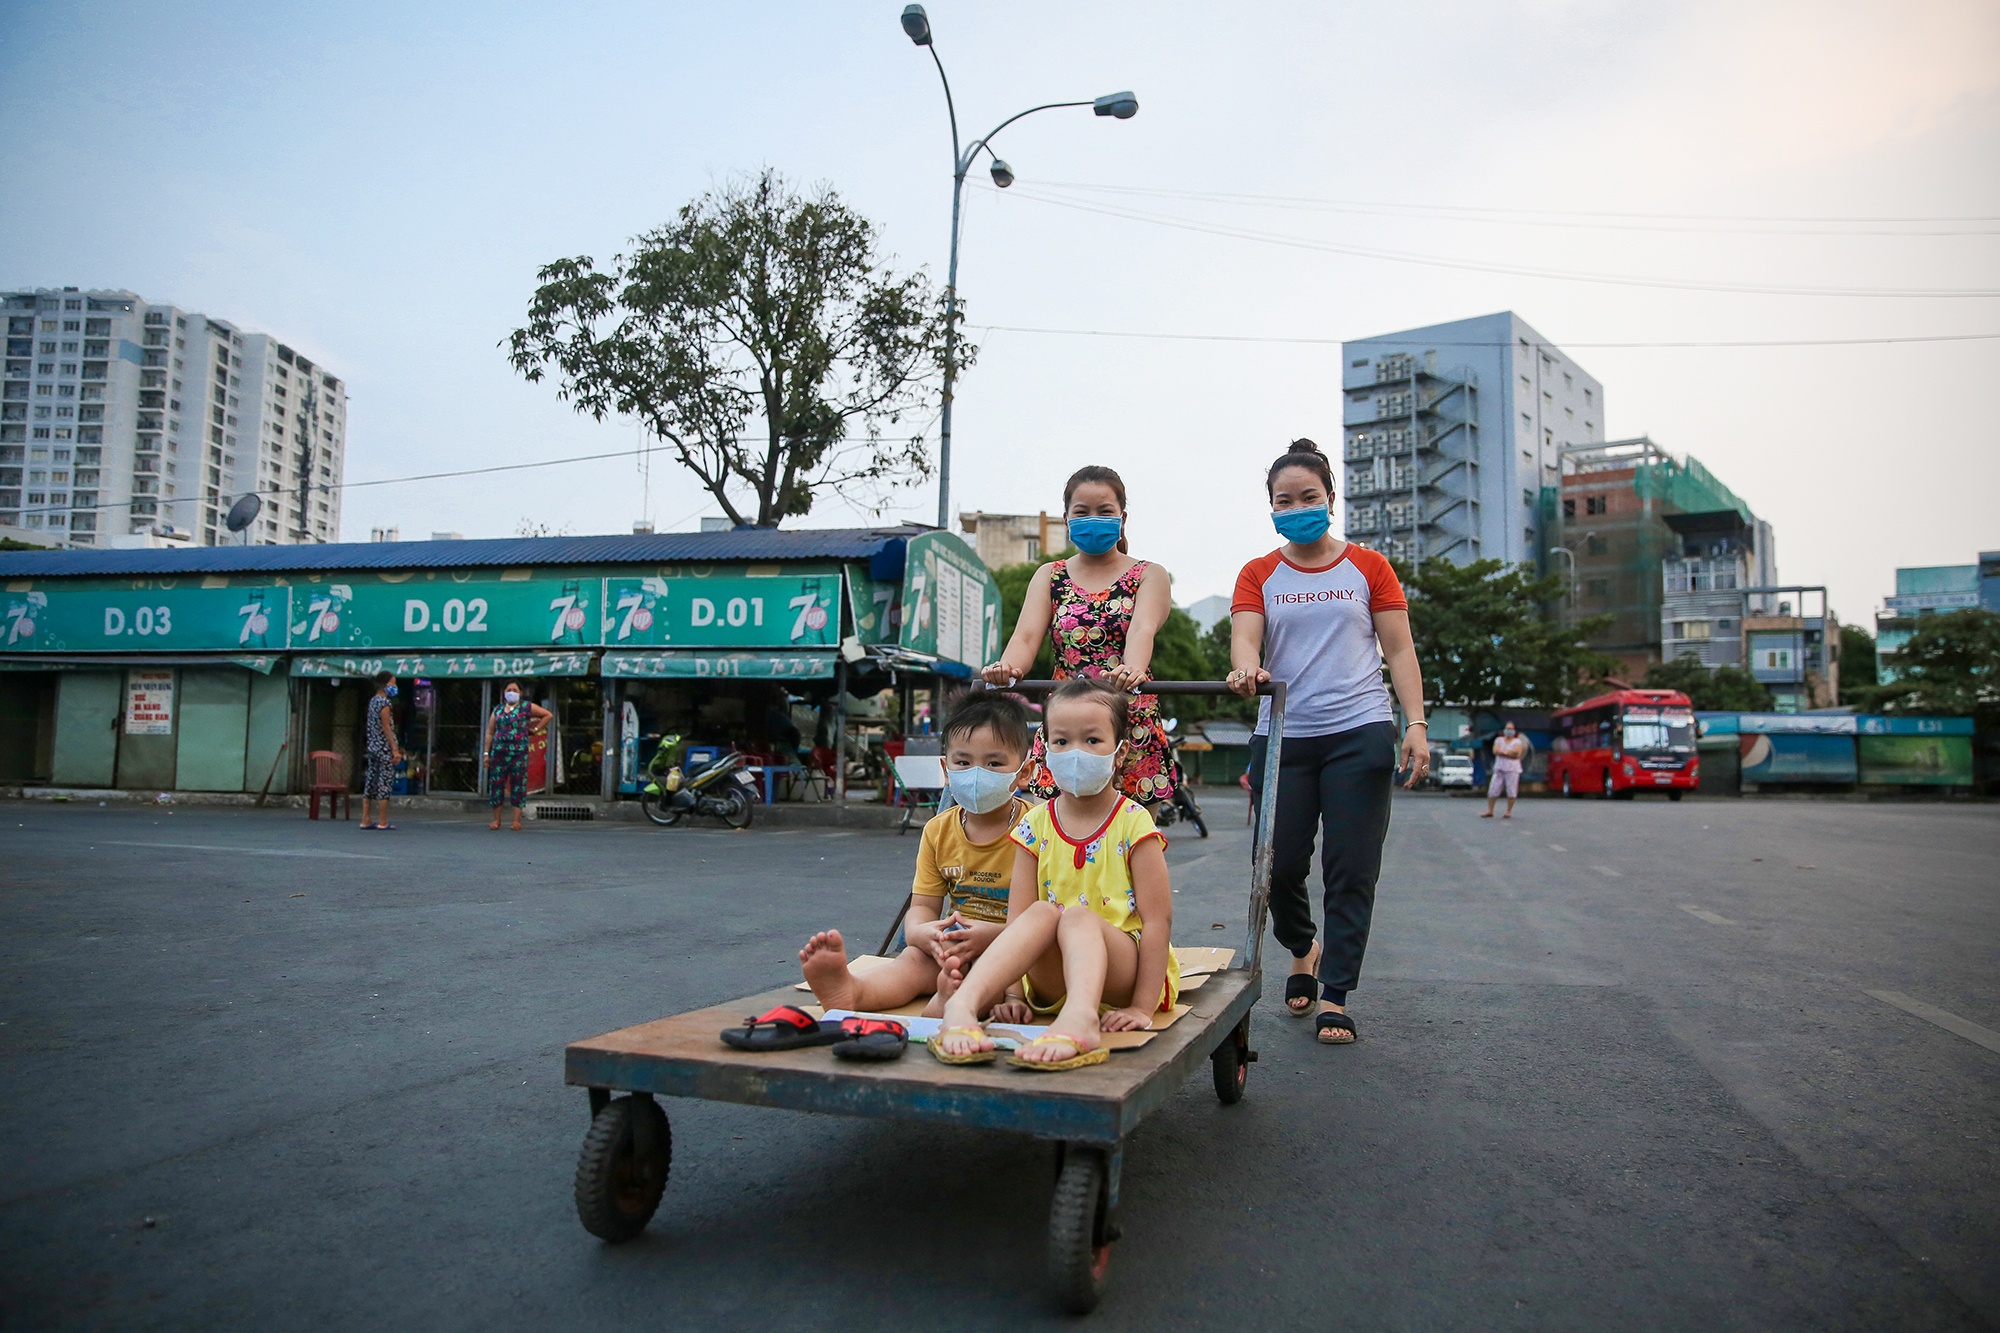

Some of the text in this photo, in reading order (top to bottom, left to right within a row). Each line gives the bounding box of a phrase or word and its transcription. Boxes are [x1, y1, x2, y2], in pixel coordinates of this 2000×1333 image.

[104, 606, 172, 636] D.03
[404, 598, 488, 633] D.02
[691, 597, 764, 627] D.01
[493, 658, 534, 675] D.02
[695, 658, 740, 677] D.01
